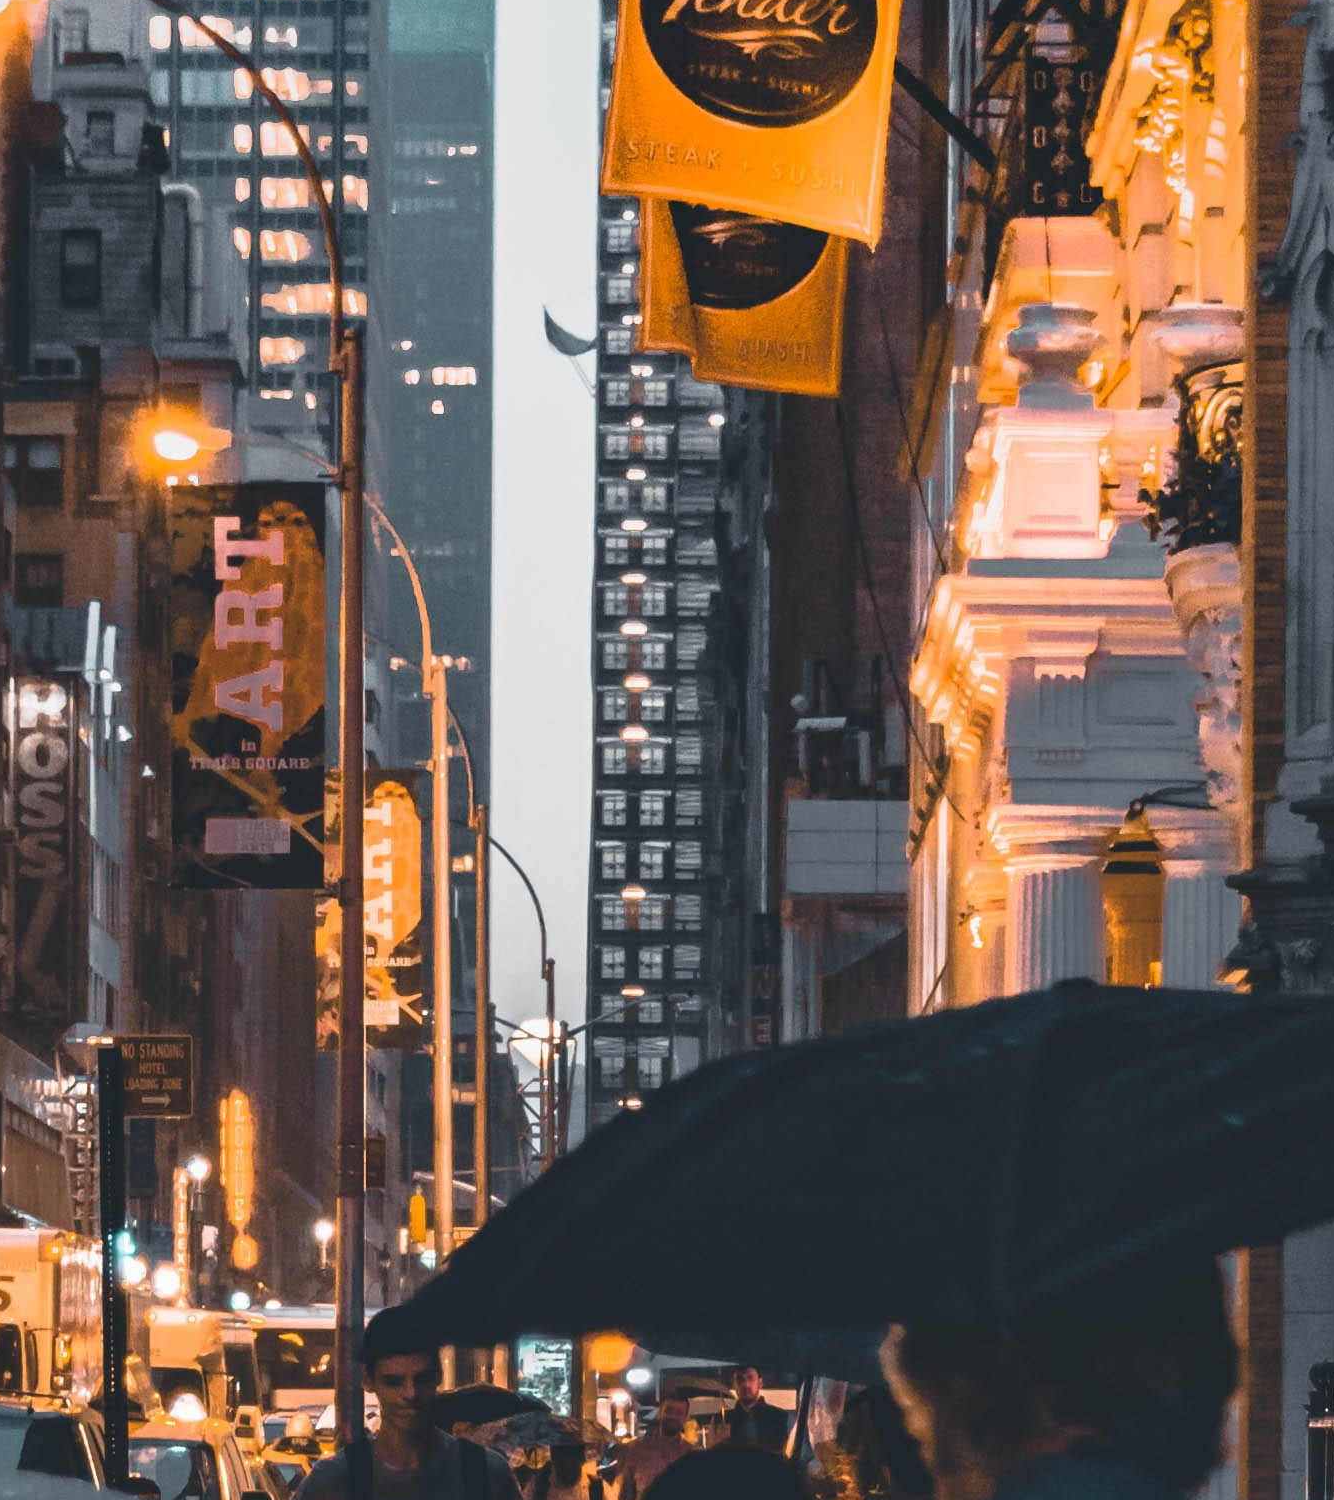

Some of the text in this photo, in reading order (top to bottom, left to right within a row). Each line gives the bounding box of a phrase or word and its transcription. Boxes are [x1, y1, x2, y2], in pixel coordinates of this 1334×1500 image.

[627, 140, 722, 170] STEAK
[771, 162, 857, 196] SUSHI
[214, 516, 284, 733] ART
[241, 738, 256, 752] in
[18, 683, 68, 879] ROSS
[189, 757, 310, 770] TIMES SQUARE
[120, 1043, 185, 1059] NO STANDING
